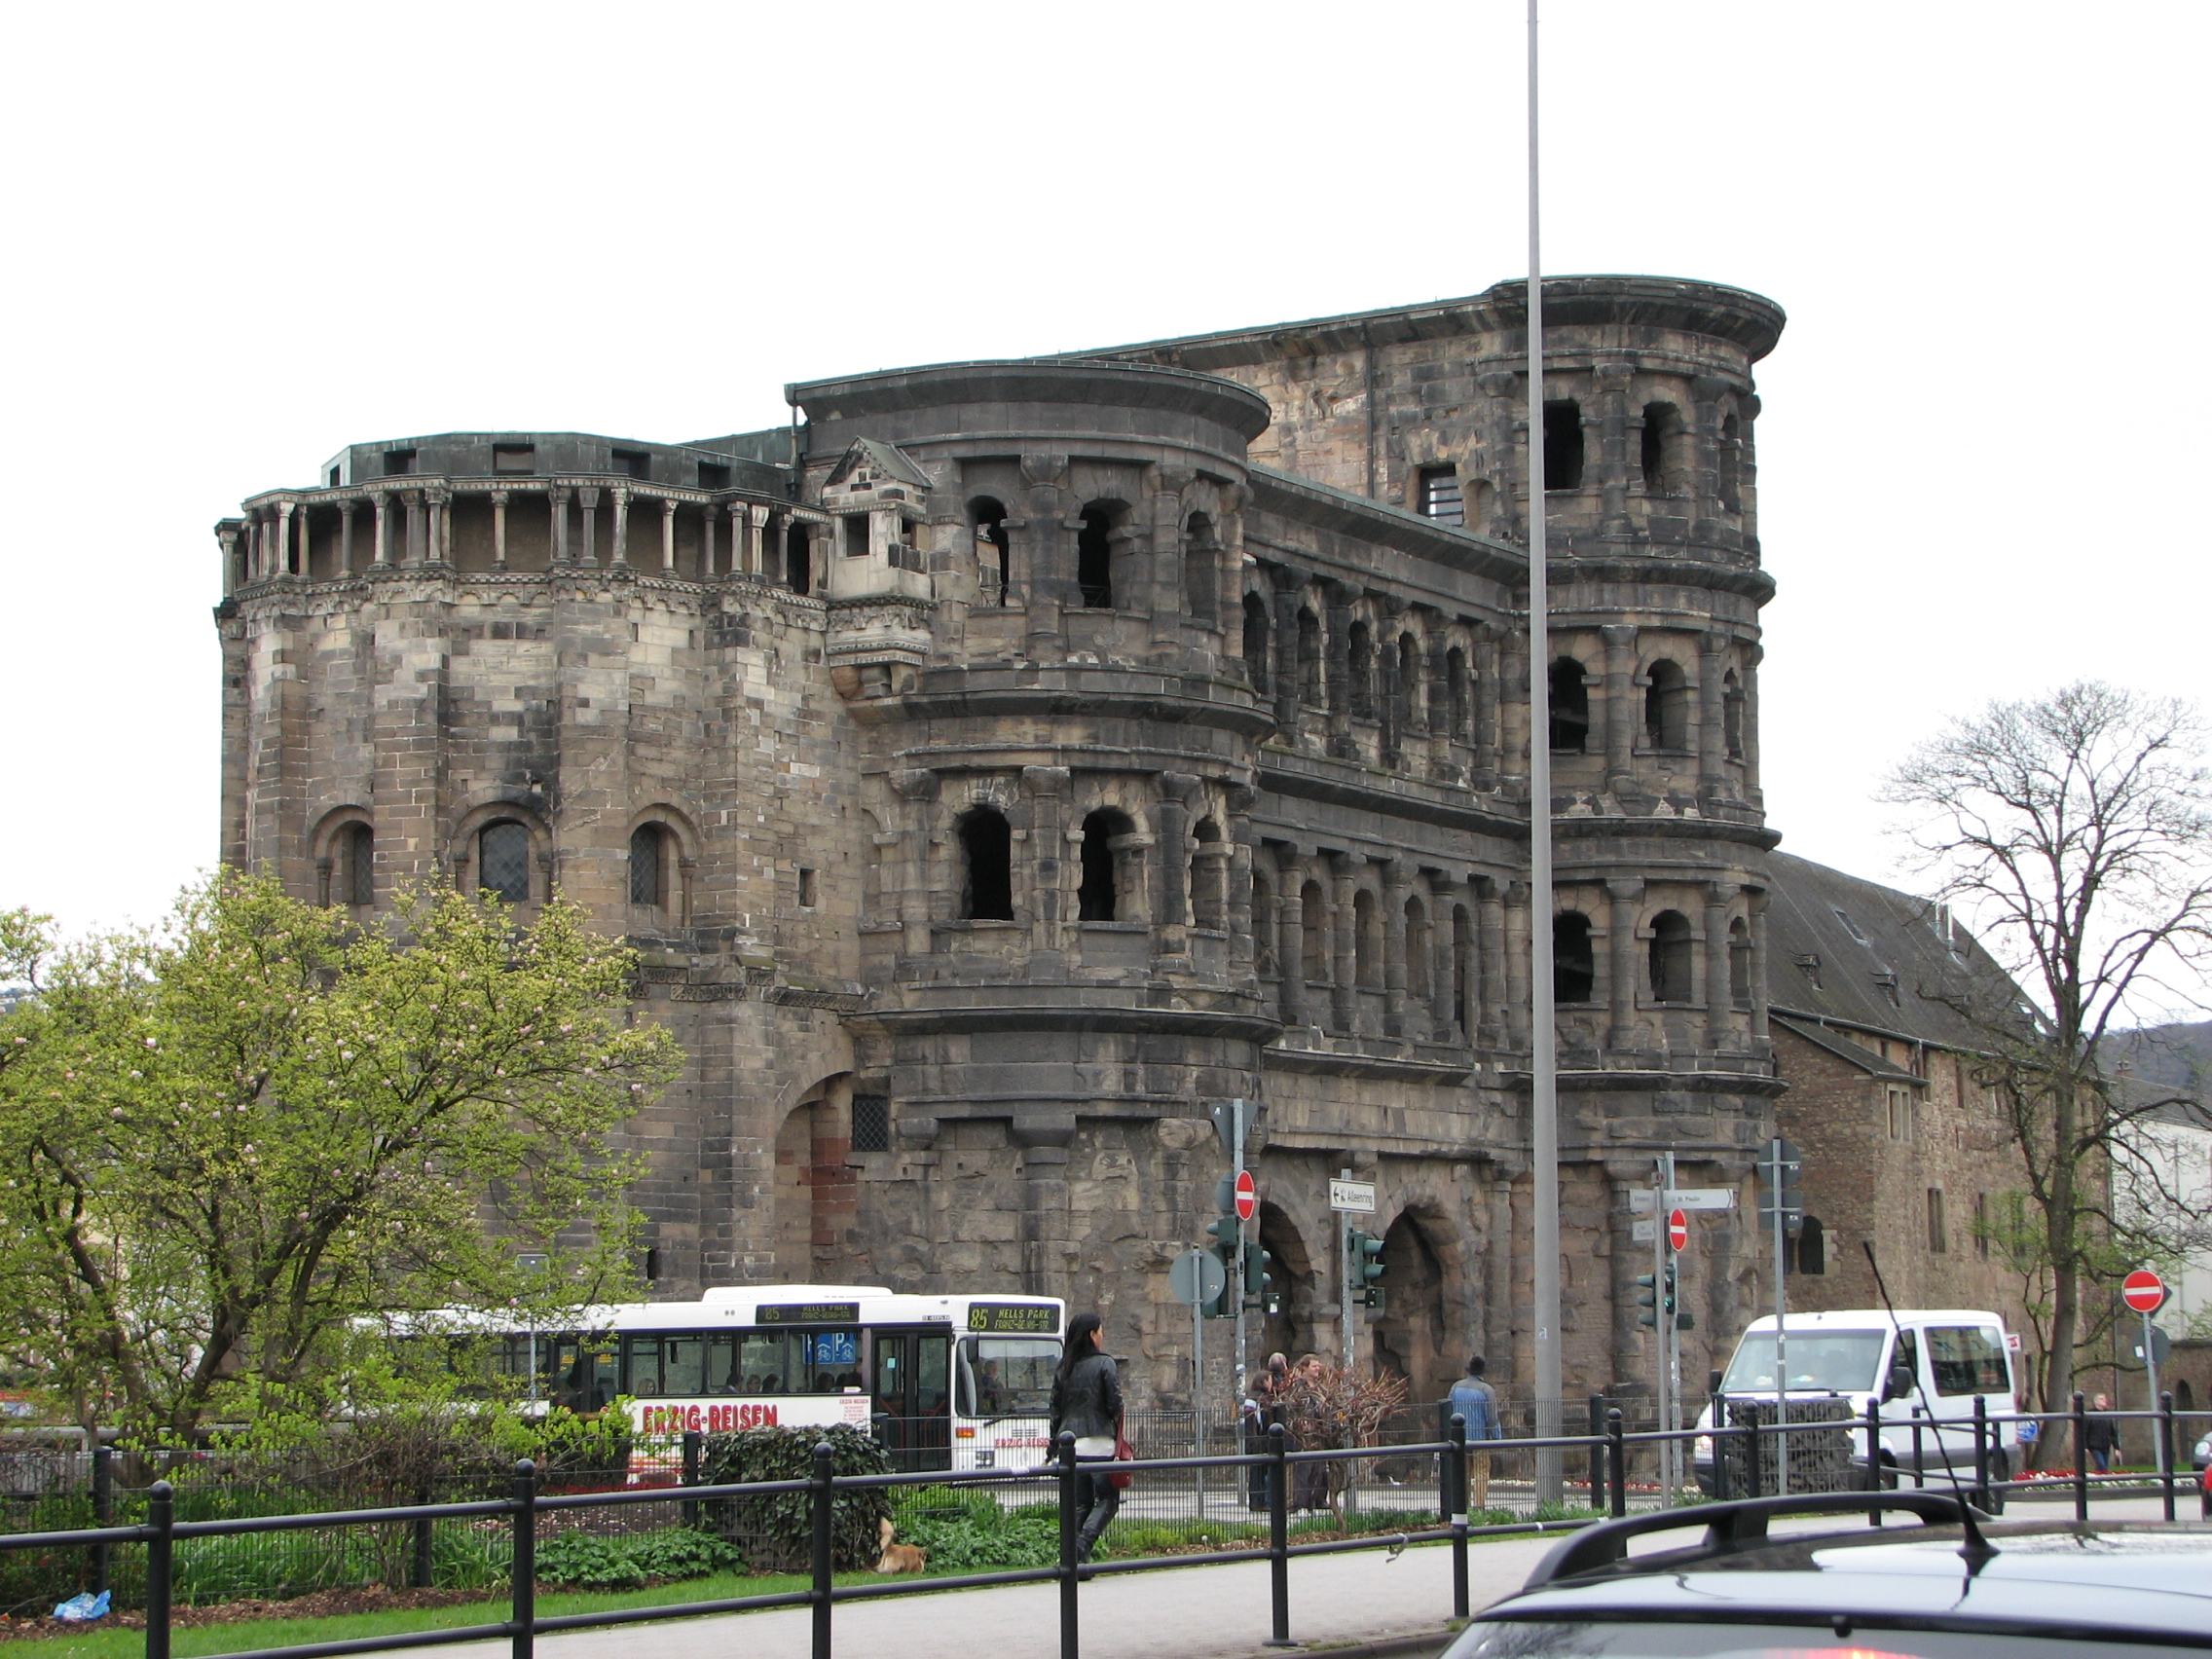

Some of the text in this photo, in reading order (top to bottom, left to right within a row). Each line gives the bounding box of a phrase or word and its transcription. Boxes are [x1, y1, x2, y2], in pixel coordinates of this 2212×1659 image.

[1346, 1190, 1373, 1207] Alleenring
[764, 1307, 781, 1320] 85
[970, 1309, 989, 1329] 85
[998, 1309, 1051, 1319] NELLS PARK
[643, 1404, 778, 1435] ERZIG-REISEN
